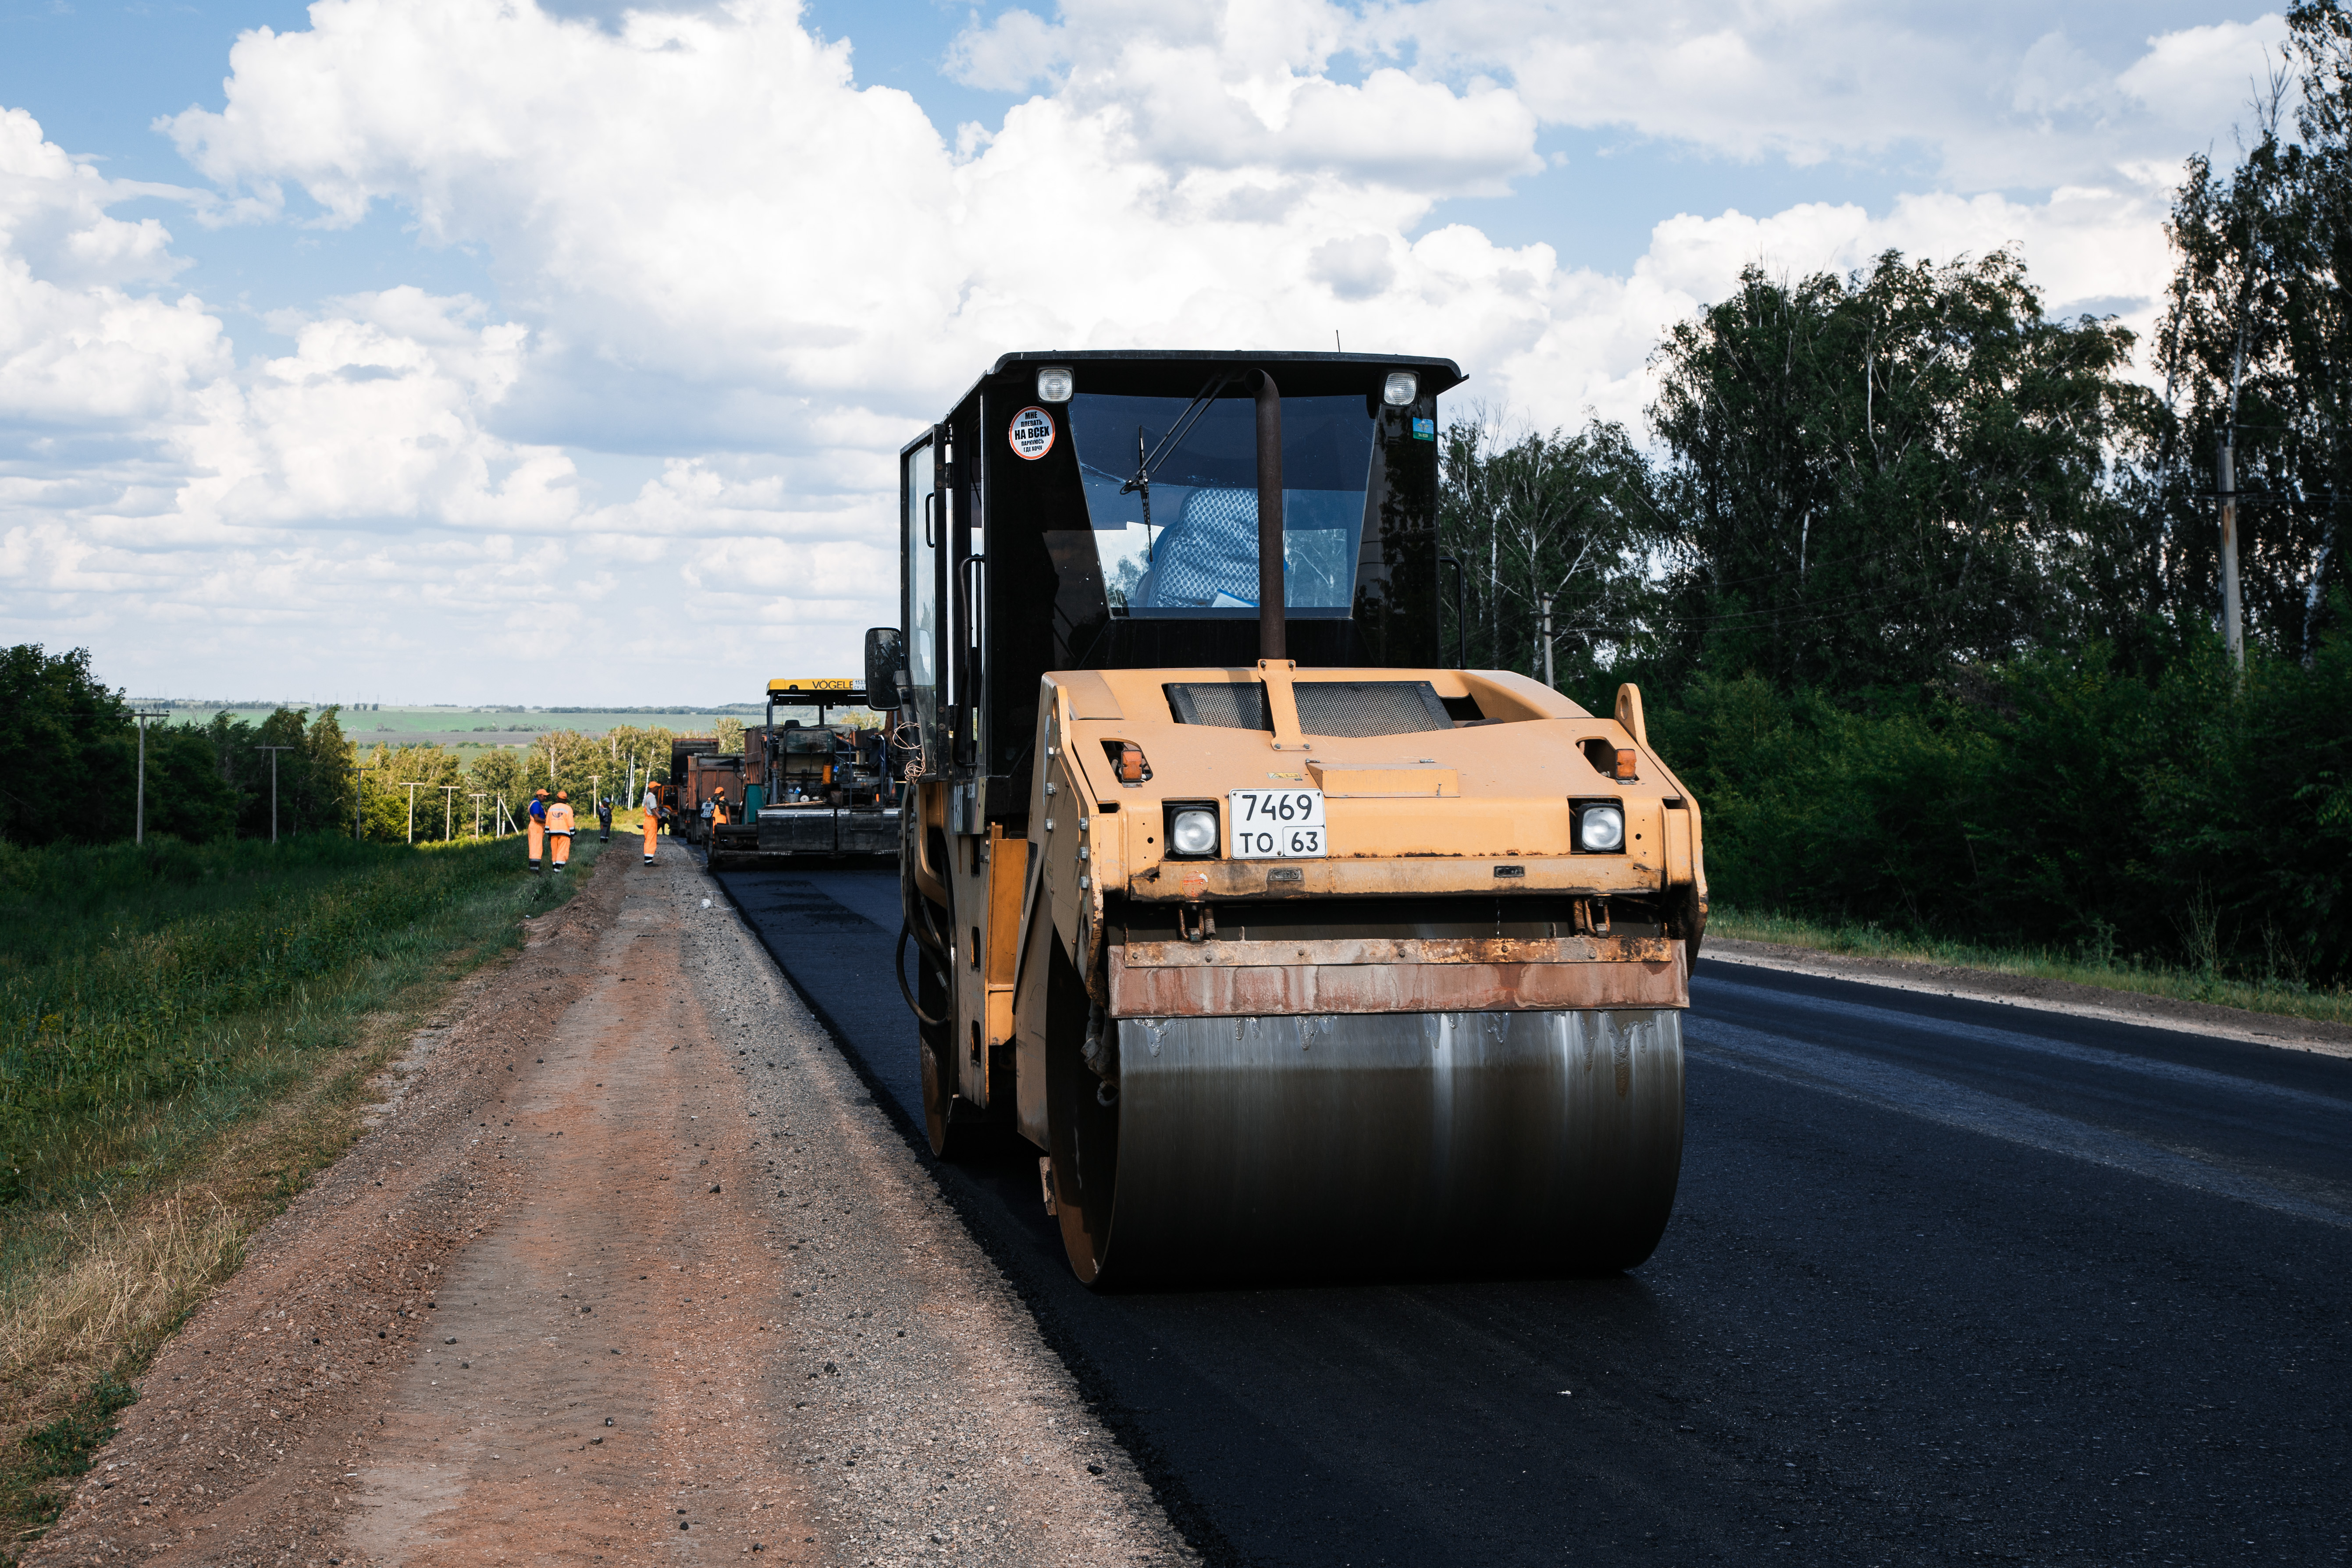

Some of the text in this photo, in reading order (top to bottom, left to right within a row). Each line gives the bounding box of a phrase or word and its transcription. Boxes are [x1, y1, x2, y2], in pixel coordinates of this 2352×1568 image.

[1021, 419, 1043, 427] ПЛЕВАТЬ
[1025, 411, 1038, 420] МНЕ
[1014, 426, 1050, 440] НА ВСЕХ
[954, 785, 963, 832] CAT
[1242, 794, 1312, 821] 7469
[1291, 832, 1318, 852] 63
